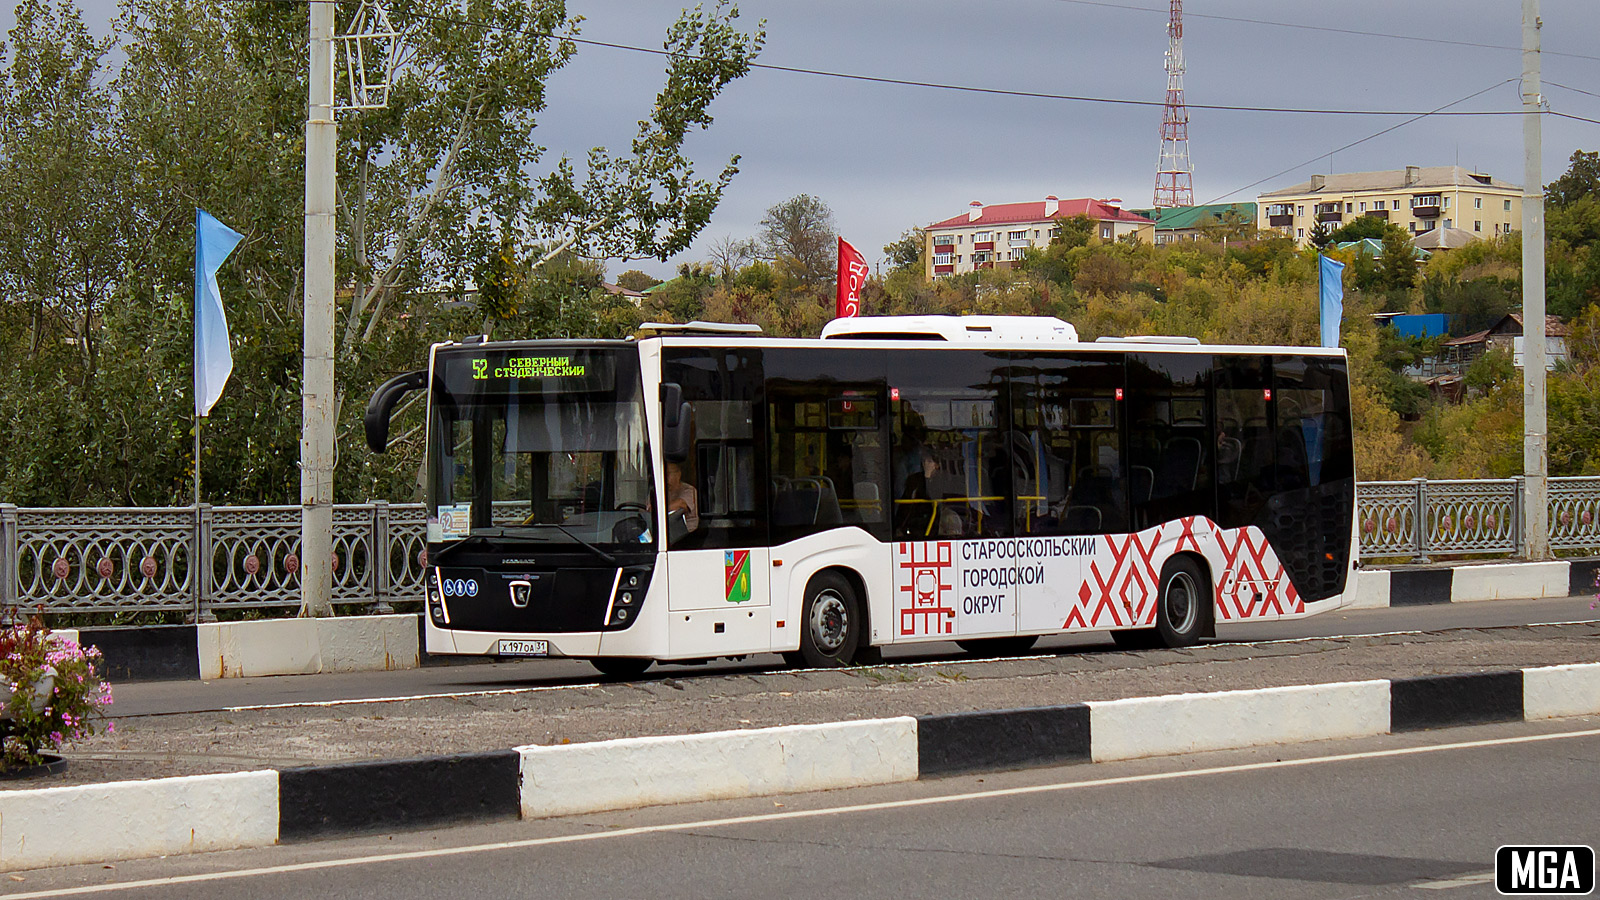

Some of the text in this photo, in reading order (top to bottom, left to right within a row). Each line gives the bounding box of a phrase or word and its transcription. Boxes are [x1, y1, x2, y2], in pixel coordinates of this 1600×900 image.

[472, 358, 488, 379] 52
[509, 356, 569, 368] СЕВЕРНЫЙ
[494, 366, 585, 379] СТУДЕНЧЕСКИЙ
[442, 515, 451, 530] 52
[963, 561, 1044, 589] ГОРОДСКОЙ
[963, 594, 1005, 615] ОКРУГ
